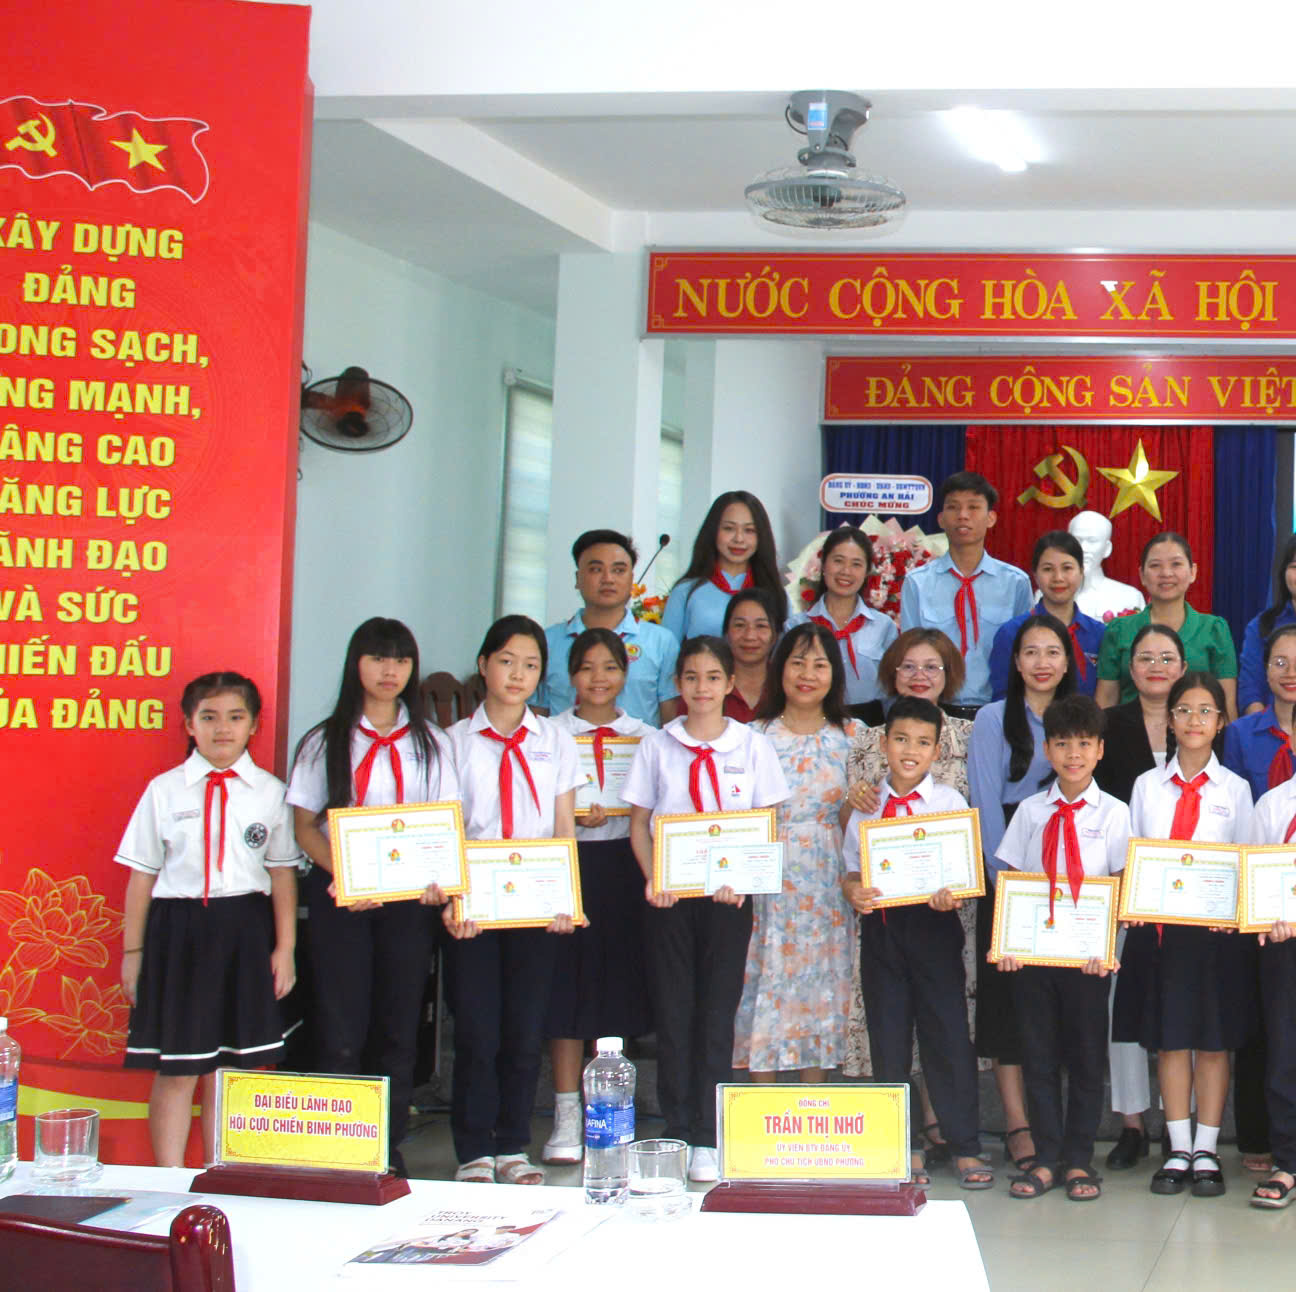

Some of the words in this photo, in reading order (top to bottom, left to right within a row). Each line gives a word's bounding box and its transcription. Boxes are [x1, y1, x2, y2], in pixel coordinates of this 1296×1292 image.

[73, 223, 184, 262] DỰNG
[23, 264, 136, 309] ĐẢNG
[674, 266, 809, 318] NƯỚC
[829, 266, 964, 327] CỘNG
[980, 268, 1079, 321] HÒA
[1099, 269, 1175, 321] XÃ
[1194, 269, 1279, 327] HỘI
[90, 328, 209, 369] SẠCH,
[69, 380, 201, 420] MẠNH,
[865, 363, 975, 408] ĐẢNG
[989, 365, 1095, 415] CỘNG
[1108, 362, 1192, 408] SẢN
[97, 434, 176, 468] CAO
[96, 485, 171, 525] LỰC
[839, 490, 879, 500] PHƯỜNG
[881, 492, 895, 500] AN
[897, 490, 915, 501] HẢI
[844, 499, 874, 508] CHÚC
[878, 500, 910, 509] MỪNG
[86, 539, 168, 578] ĐẠO
[56, 586, 139, 624] SỨC
[89, 635, 172, 677] ĐẤU
[51, 688, 165, 730] ĐẢNG
[254, 1093, 272, 1111] ĐẠI
[274, 1090, 298, 1110] BIỂU
[301, 1094, 328, 1112] LÃNH
[331, 1098, 353, 1116] ĐẠO
[229, 1112, 247, 1133] HỘI
[249, 1116, 271, 1134] CỰU
[272, 1115, 304, 1134] CHIẾN
[306, 1120, 332, 1136] BINH
[334, 1120, 379, 1139] PHƯỜNG
[806, 1115, 830, 1139] THỊ
